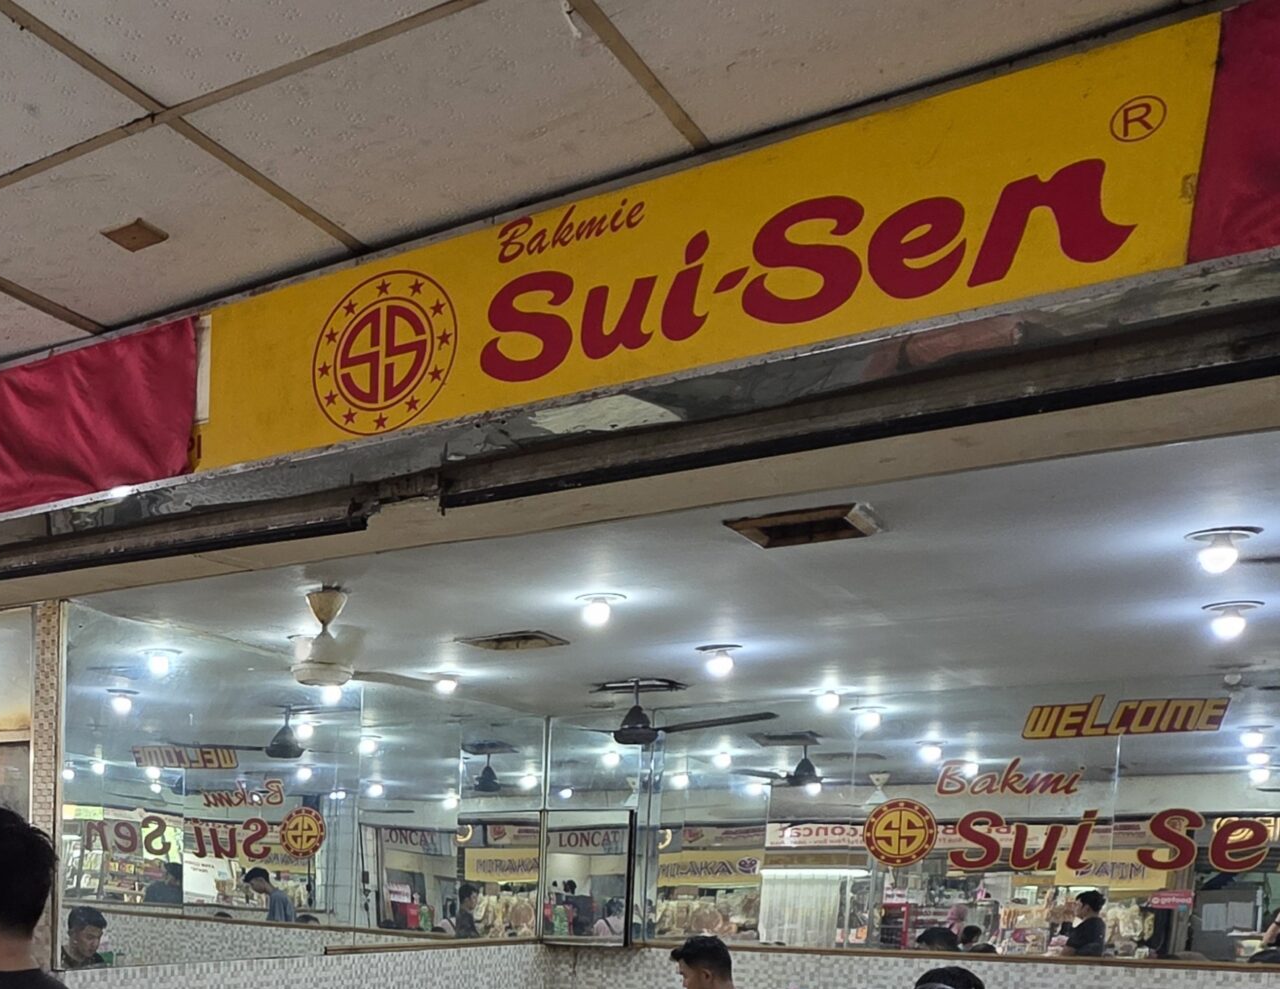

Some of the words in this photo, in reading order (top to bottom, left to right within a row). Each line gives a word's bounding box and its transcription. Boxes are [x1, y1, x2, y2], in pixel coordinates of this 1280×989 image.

[497, 198, 645, 264] Bakmie
[479, 158, 1139, 383] Sui-Sen
[1023, 695, 1229, 740] WELCOME
[936, 757, 1086, 796] Bakmi
[558, 830, 620, 849] LONCAT
[948, 808, 1099, 871] Sui
[1136, 807, 1280, 872] Se
